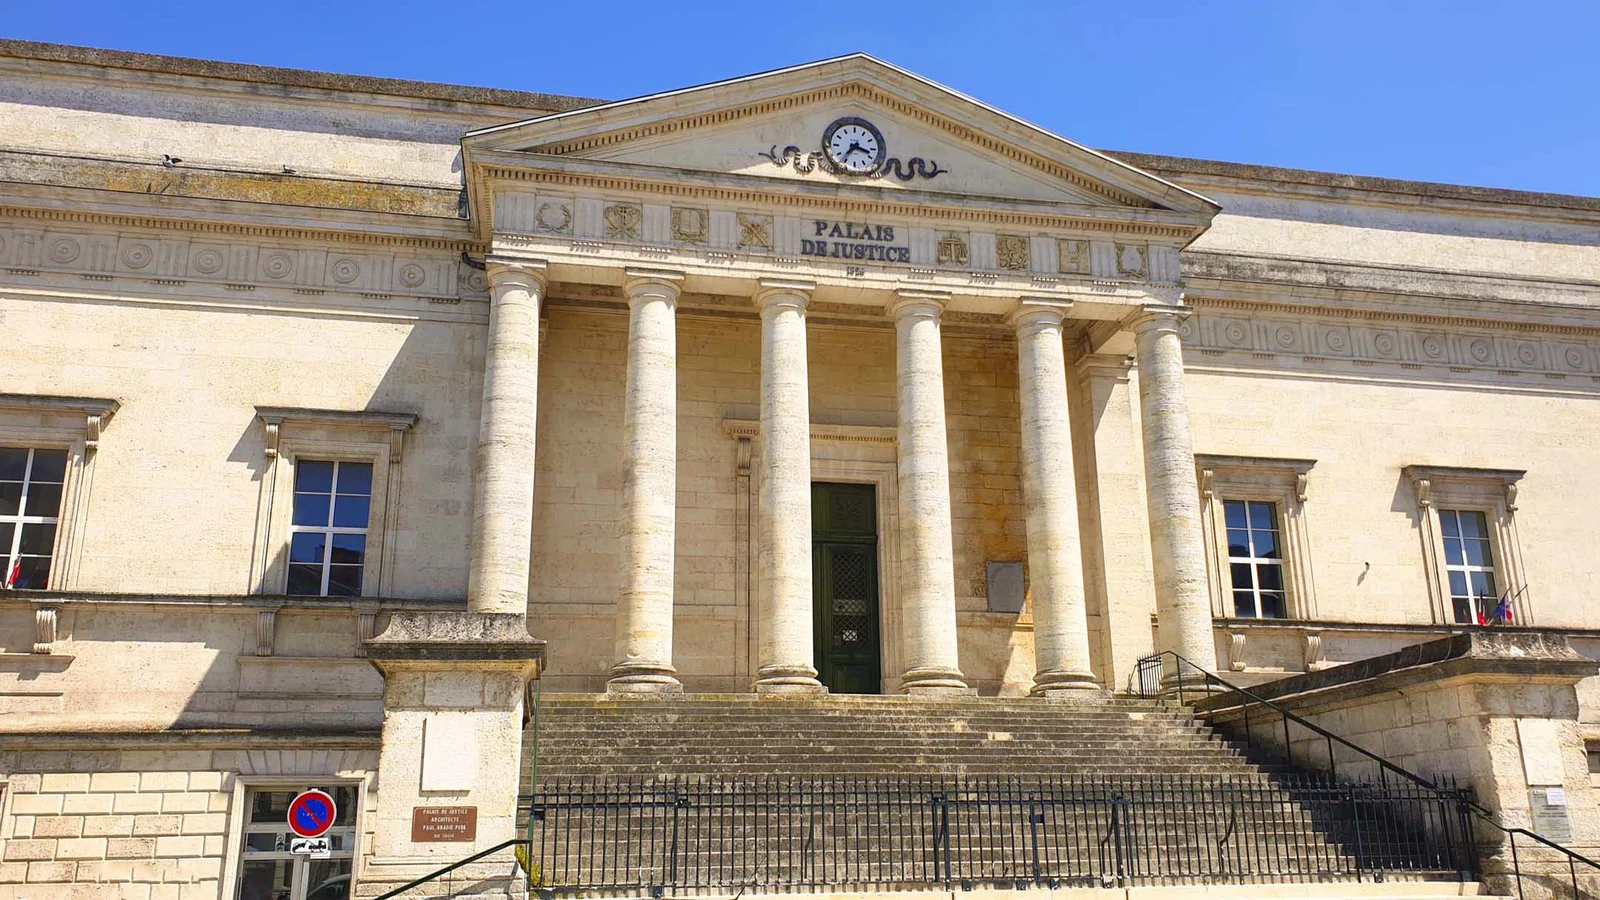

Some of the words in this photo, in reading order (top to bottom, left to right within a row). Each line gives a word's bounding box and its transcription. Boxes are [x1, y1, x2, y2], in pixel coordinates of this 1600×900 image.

[814, 220, 894, 242] PALAIS
[801, 239, 828, 257] DE
[831, 242, 911, 263] JUSTICE
